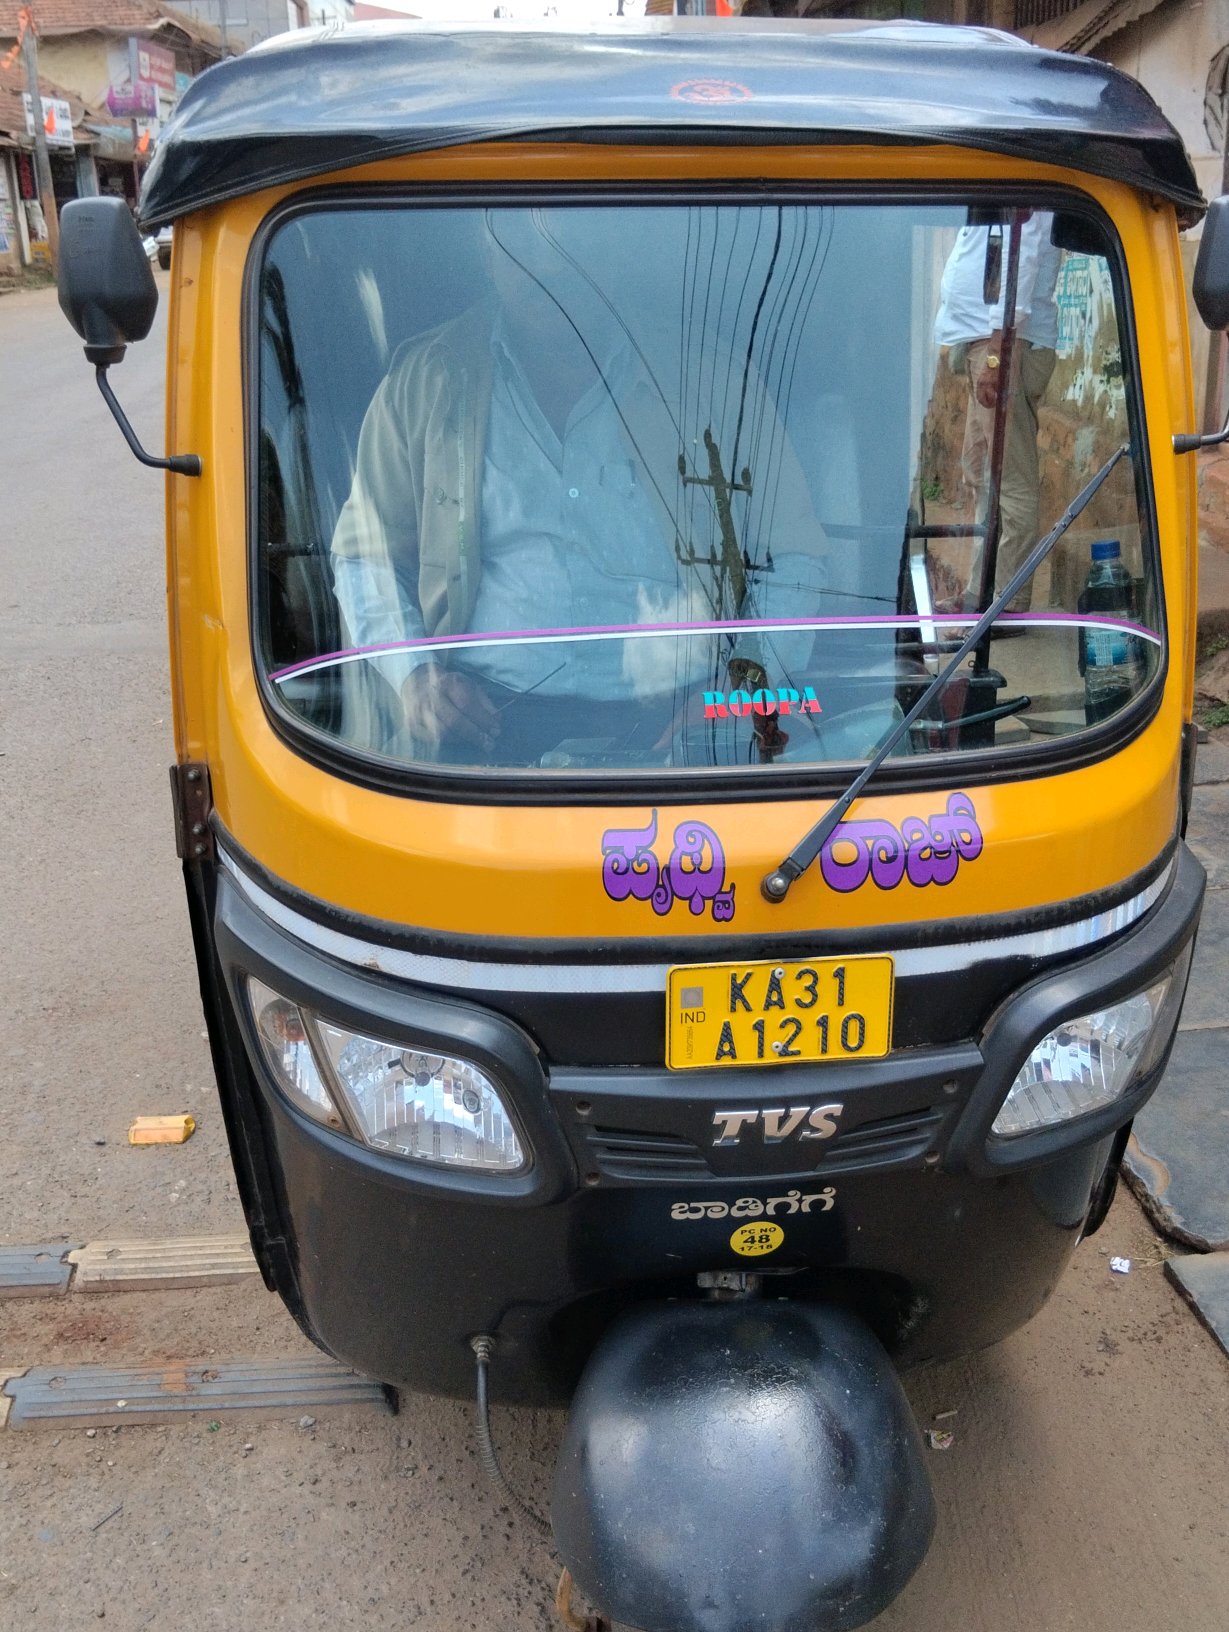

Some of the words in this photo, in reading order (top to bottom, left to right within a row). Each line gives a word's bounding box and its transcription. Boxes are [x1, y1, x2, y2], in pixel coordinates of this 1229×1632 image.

[702, 686, 822, 718] ROOPA
[820, 792, 983, 893] ರಾಜ್
[729, 965, 846, 1013] KA31
[680, 1011, 706, 1024] IND
[715, 1013, 866, 1060] A1210
[712, 1104, 844, 1147] TVS
[670, 1186, 836, 1220] ಬಾಡಿಗೆಗೆ
[740, 1228, 756, 1236] PC
[760, 1226, 777, 1234] NO
[743, 1234, 771, 1245] 48
